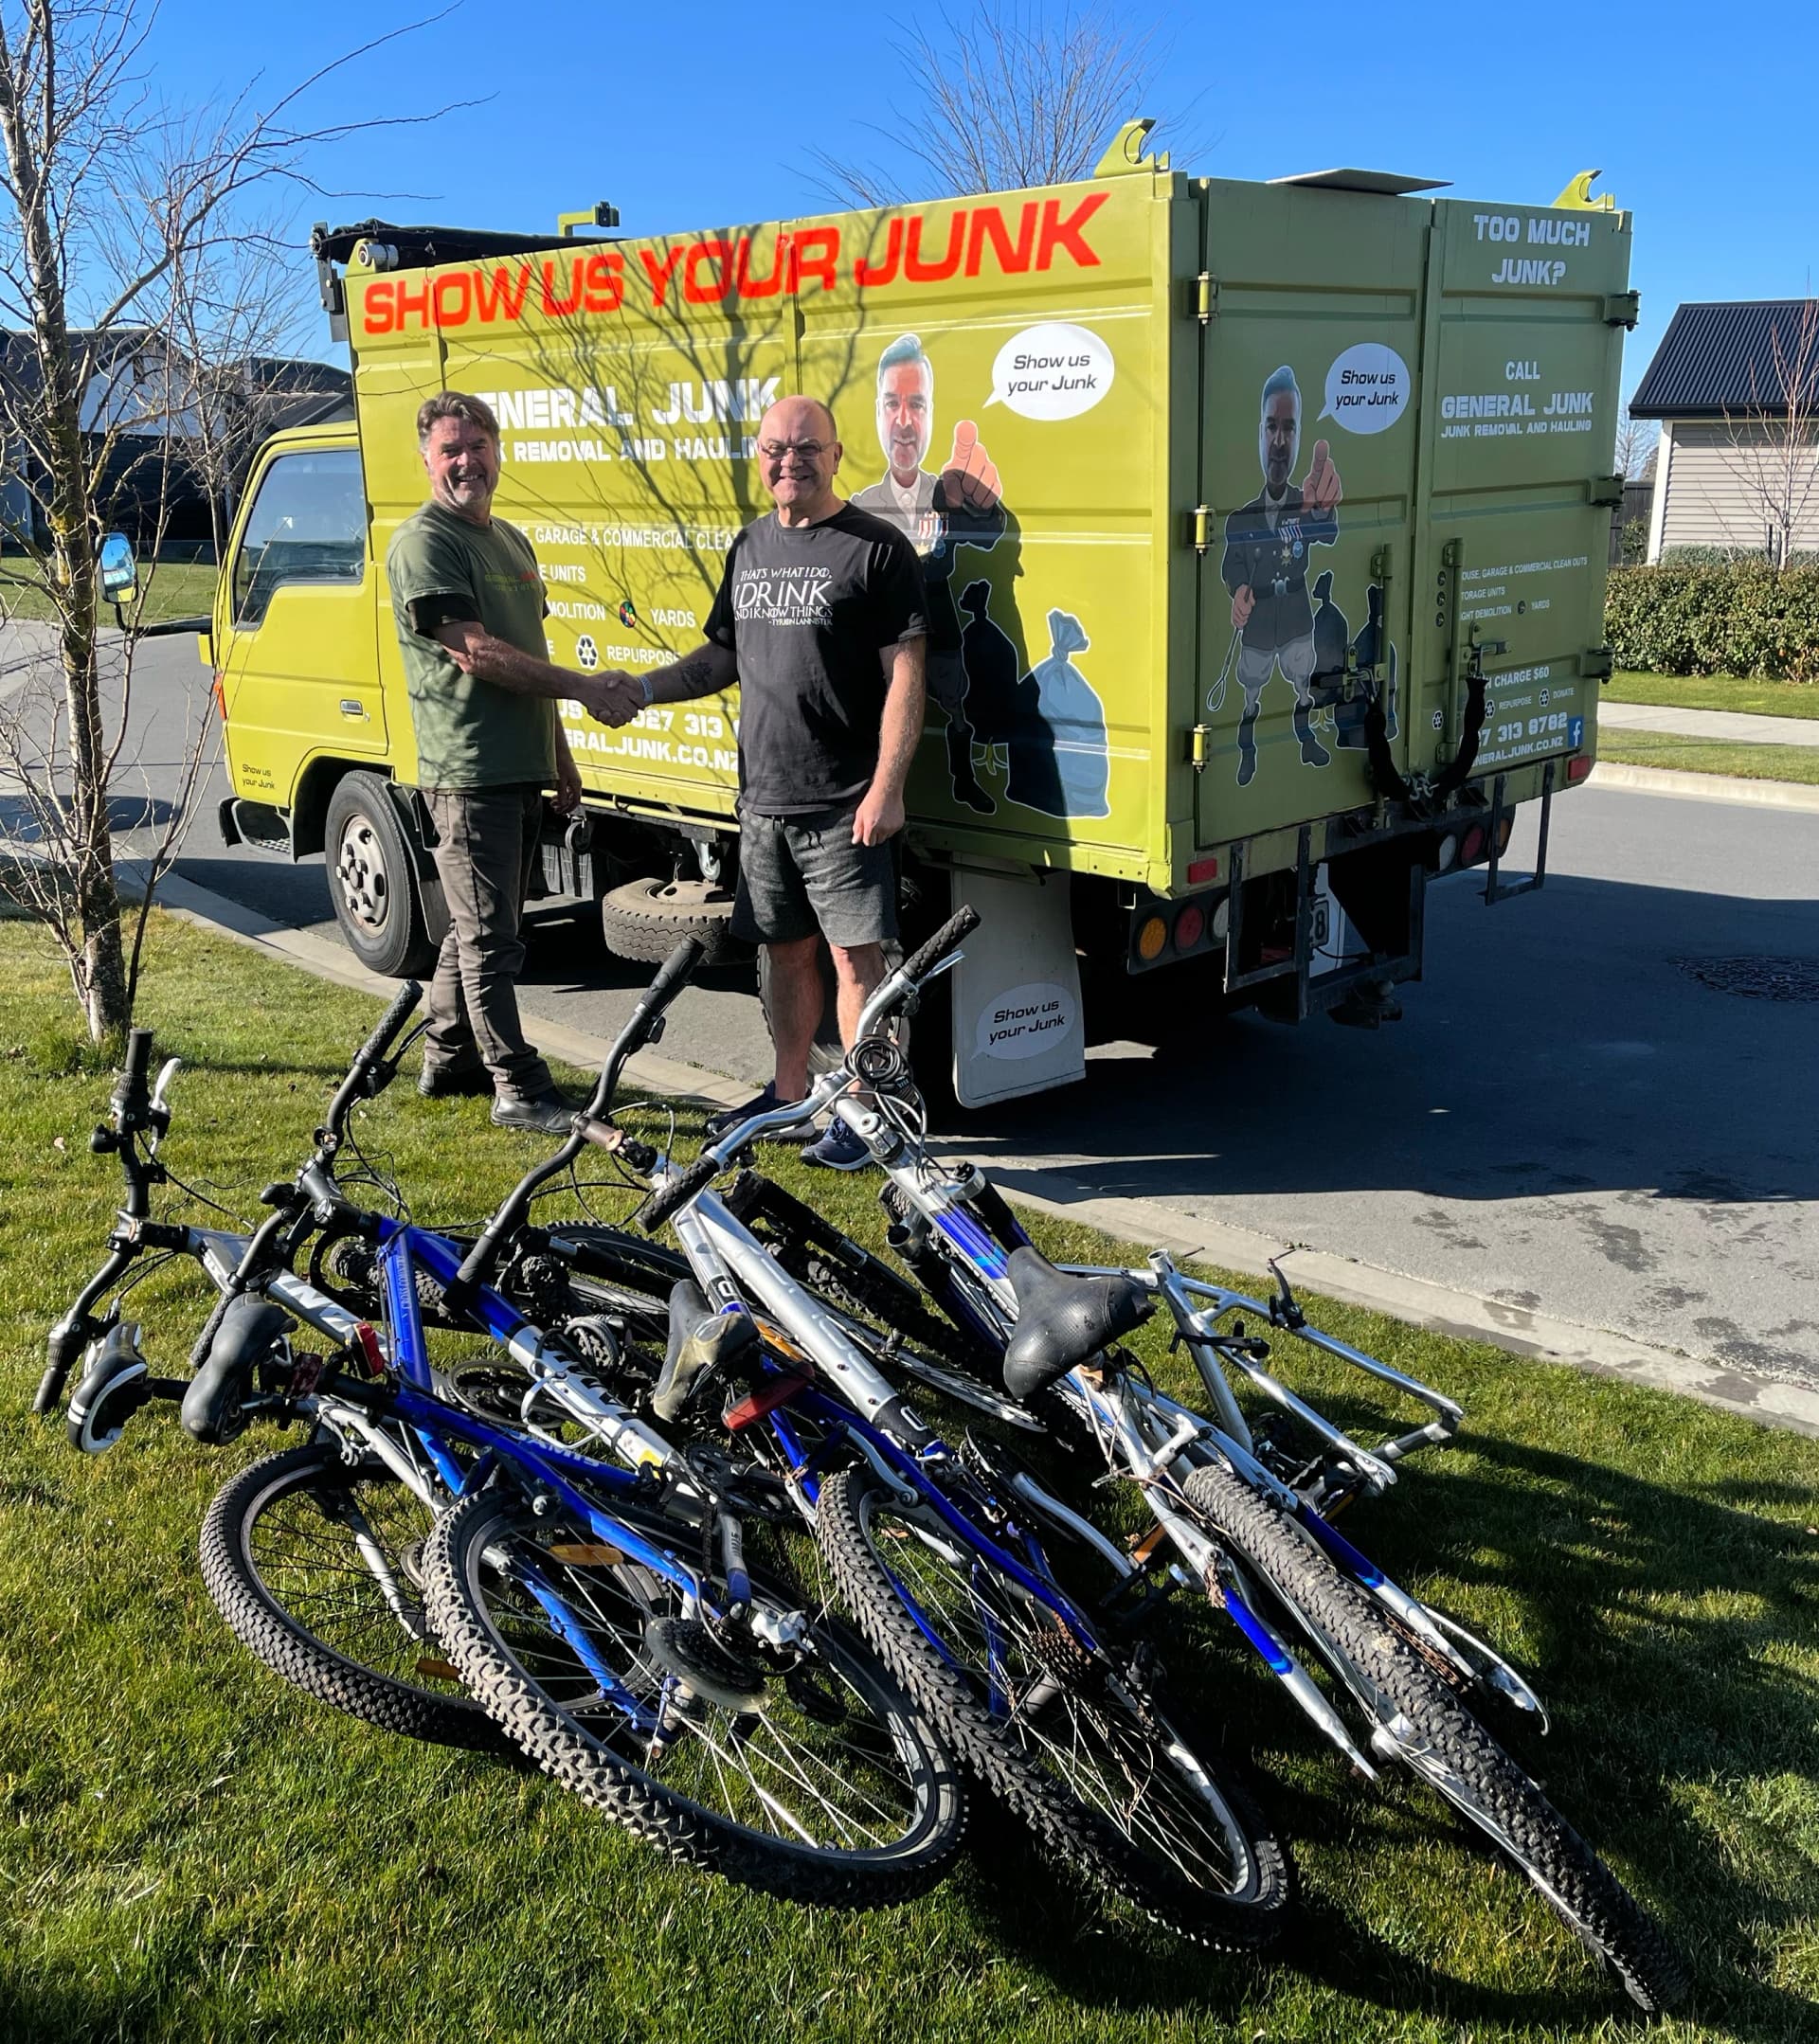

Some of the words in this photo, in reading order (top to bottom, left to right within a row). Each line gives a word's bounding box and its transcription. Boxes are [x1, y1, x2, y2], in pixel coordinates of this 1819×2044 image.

[1473, 214, 1520, 243] TOO
[1527, 218, 1592, 247] MUCH
[364, 263, 531, 334] SHOW
[542, 253, 623, 317] US
[639, 226, 841, 307] YOUR
[855, 192, 1110, 287] JUNK
[1491, 258, 1566, 285] JUNK?
[1014, 353, 1065, 370] Show
[1067, 352, 1090, 368] us
[1505, 361, 1540, 381] CALL
[1007, 378, 1049, 397] your
[1052, 374, 1097, 391] Junk
[1341, 369, 1378, 385] Show
[1378, 373, 1396, 385] us
[473, 385, 634, 430] ENERAL
[652, 377, 782, 424] JUNK
[1335, 395, 1366, 410] your
[1367, 392, 1398, 406] Junk
[1441, 394, 1536, 419] GENERAL
[1543, 392, 1594, 415] JUNK
[1441, 424, 1470, 439] JUNK
[1474, 422, 1523, 438] REMOVAL
[1526, 421, 1548, 435] AND
[1550, 419, 1593, 433] HAULING
[513, 440, 611, 462] REMOVAL
[620, 439, 666, 461] AND
[674, 436, 759, 460] HAULIN
[535, 528, 587, 545] GARAGE
[591, 529, 601, 546] &
[603, 529, 693, 548] COMMERCIAL
[696, 529, 738, 550] CLEA
[550, 565, 586, 583] UNITS
[771, 566, 805, 578] WHAT
[804, 567, 810, 578] I
[1461, 570, 1481, 581] OUSE,
[1482, 567, 1508, 579] GARAGE
[1514, 560, 1553, 574] COMMERCIAL
[1554, 559, 1572, 569] CLEAN
[1572, 556, 1588, 566] OUTS
[738, 581, 833, 609] DRINK
[1461, 588, 1486, 601] TORAGE
[1487, 586, 1505, 598] UNITS
[546, 601, 605, 620] MOLITION
[753, 606, 789, 619] KNOW
[790, 606, 834, 618] THINGS
[1461, 610, 1474, 621] GHT
[1474, 605, 1512, 619] DEMOLITION
[1531, 599, 1550, 610] YARDS
[651, 608, 696, 627] YARDS
[1494, 669, 1532, 688] CHARGE
[1533, 666, 1549, 680] $60
[1499, 696, 1532, 710] REPURPOSE
[1554, 688, 1575, 699] DONATE
[683, 712, 723, 739] 313
[1498, 722, 1522, 743] 313
[564, 728, 739, 772] ERALJUNK.CO.NZ
[1471, 736, 1563, 767] NERALJUNK.CO.NZ
[242, 763, 261, 775] Show
[242, 778, 258, 787] your
[258, 780, 275, 789] Junk
[994, 1005, 1038, 1024] Show
[1042, 1000, 1059, 1013] us
[989, 1026, 1025, 1046] your
[1029, 1014, 1065, 1032] Junk
